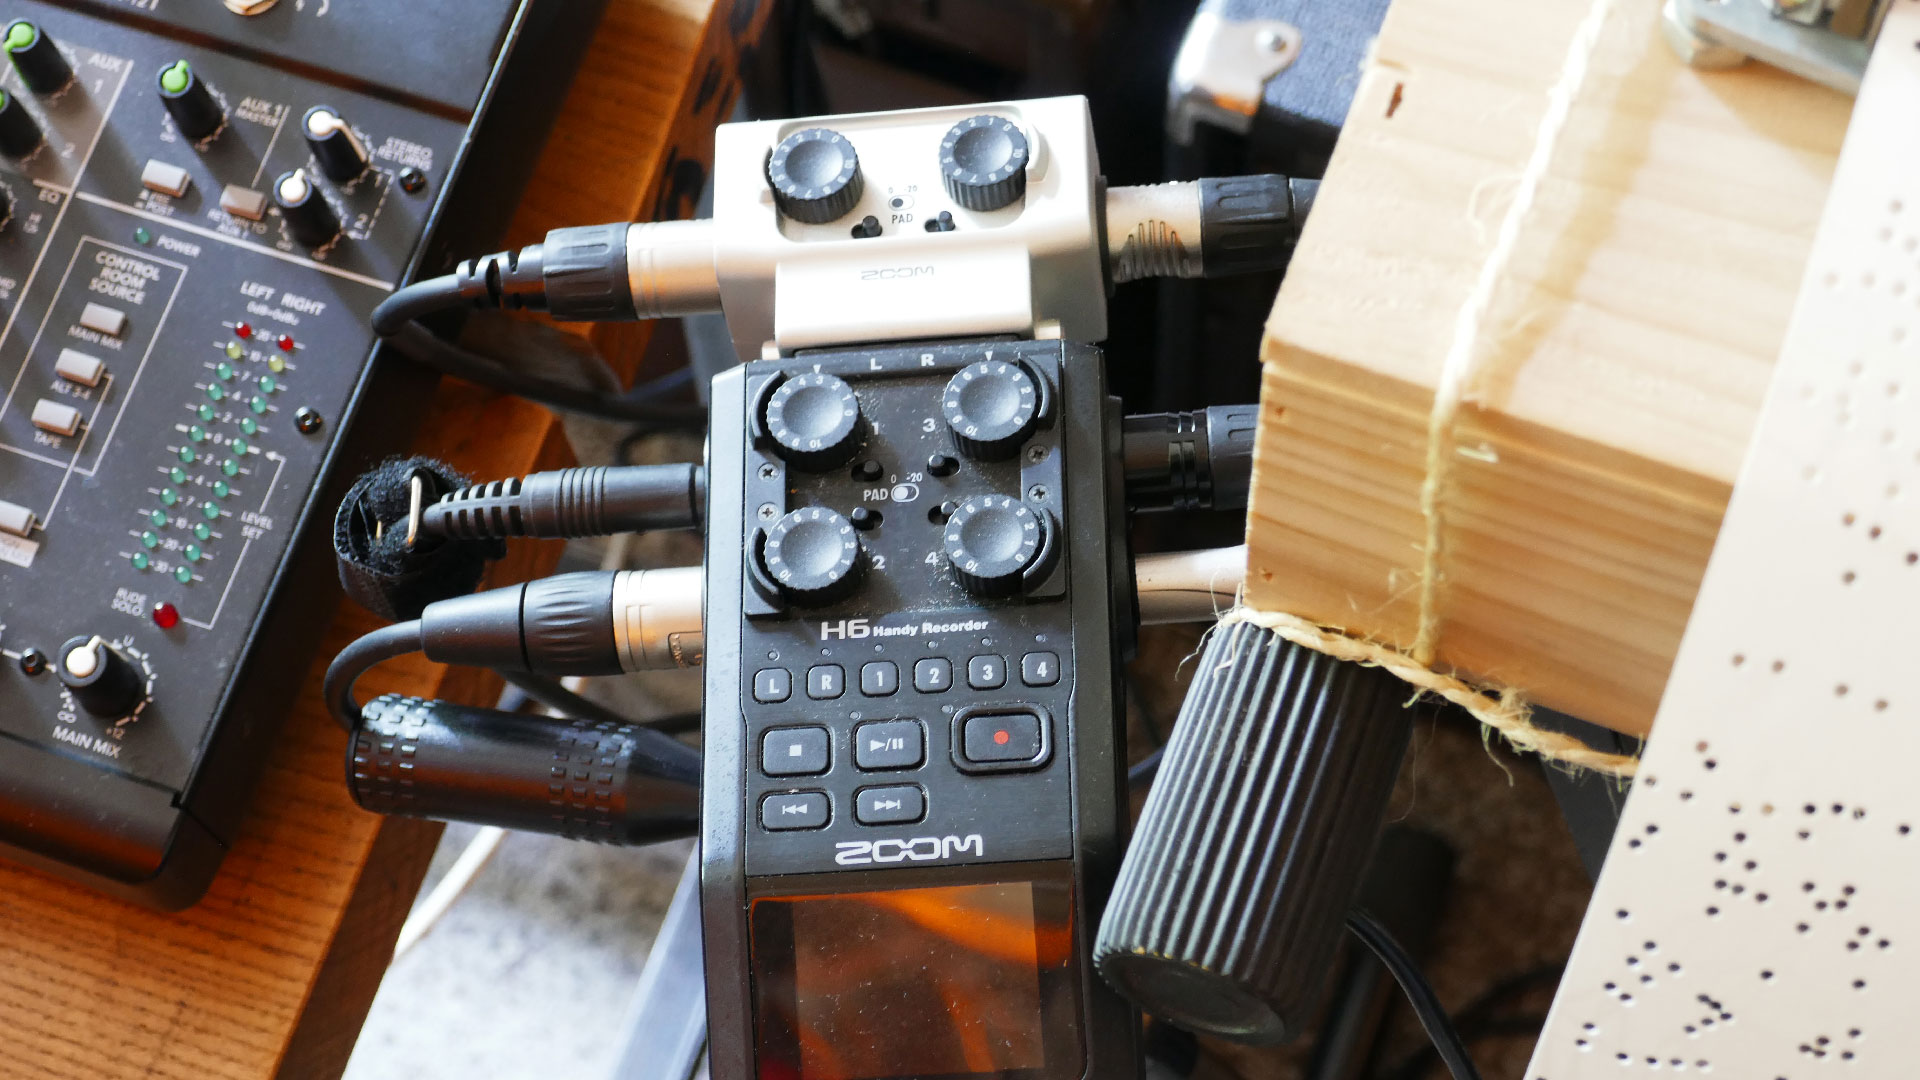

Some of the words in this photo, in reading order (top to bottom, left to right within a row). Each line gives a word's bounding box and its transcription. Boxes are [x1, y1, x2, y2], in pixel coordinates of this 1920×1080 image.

[88, 53, 121, 72] AUX
[240, 96, 271, 113] AUX
[386, 137, 433, 158] STEREO
[376, 145, 433, 171] RETURNS
[892, 214, 913, 224] PAD
[157, 235, 201, 258] POWER
[95, 251, 160, 281] CONTROL
[101, 266, 146, 289] ROOM
[861, 266, 934, 280] ZOOM
[88, 277, 146, 305] SOURCE
[240, 280, 276, 301] LEFT
[281, 292, 327, 316] RIGHT
[67, 324, 101, 344] MAIN
[100, 334, 124, 351] MIX
[870, 358, 882, 370] L
[921, 354, 935, 366] R
[980, 364, 988, 374] 5
[998, 365, 1006, 374] 4
[816, 376, 824, 384] 3
[962, 372, 972, 381] 6
[1012, 373, 1022, 382] 3
[50, 380, 73, 395] ALT
[782, 386, 792, 394] 5
[831, 381, 840, 391] 2
[950, 384, 960, 392] 7
[1020, 386, 1032, 394] 2
[946, 400, 958, 408] 8
[922, 418, 936, 432] 3
[952, 416, 962, 424] 9
[1014, 416, 1023, 425] 0
[871, 422, 879, 436] 1
[966, 425, 978, 436] 10
[792, 438, 800, 446] 9
[809, 439, 822, 448] 10
[890, 474, 896, 484] 0
[906, 472, 922, 482] -20
[864, 488, 888, 501] PAD
[984, 498, 992, 507] 5
[1002, 499, 1010, 508] 4
[966, 504, 975, 514] 6
[1016, 508, 1026, 516] 3
[794, 514, 802, 522] 6
[812, 510, 820, 520] 5
[829, 514, 838, 524] 4
[240, 510, 273, 531] LEVEL
[952, 517, 963, 526] 7
[777, 524, 787, 533] 7
[840, 526, 851, 534] 3
[1024, 522, 1034, 530] 2
[240, 524, 264, 540] SET
[770, 540, 780, 548] 8
[952, 549, 963, 558] 9
[1015, 554, 1025, 562] 0
[872, 555, 886, 570] 2
[925, 552, 939, 566] 4
[966, 560, 978, 572] 10
[780, 569, 792, 582] 10
[828, 571, 838, 580] 0
[115, 587, 147, 606] RUDE
[111, 598, 145, 617] SOLO
[820, 618, 870, 640] H6
[873, 624, 918, 637] Handy
[922, 620, 988, 634] Recorder
[769, 678, 780, 694] L
[821, 674, 832, 690] R
[876, 670, 883, 687] 1
[929, 667, 940, 684] 2
[982, 664, 994, 680] 3
[1036, 662, 1048, 678] 4
[52, 725, 93, 749] MAIN
[92, 738, 122, 759] MIX
[834, 834, 984, 866] ZOOM
